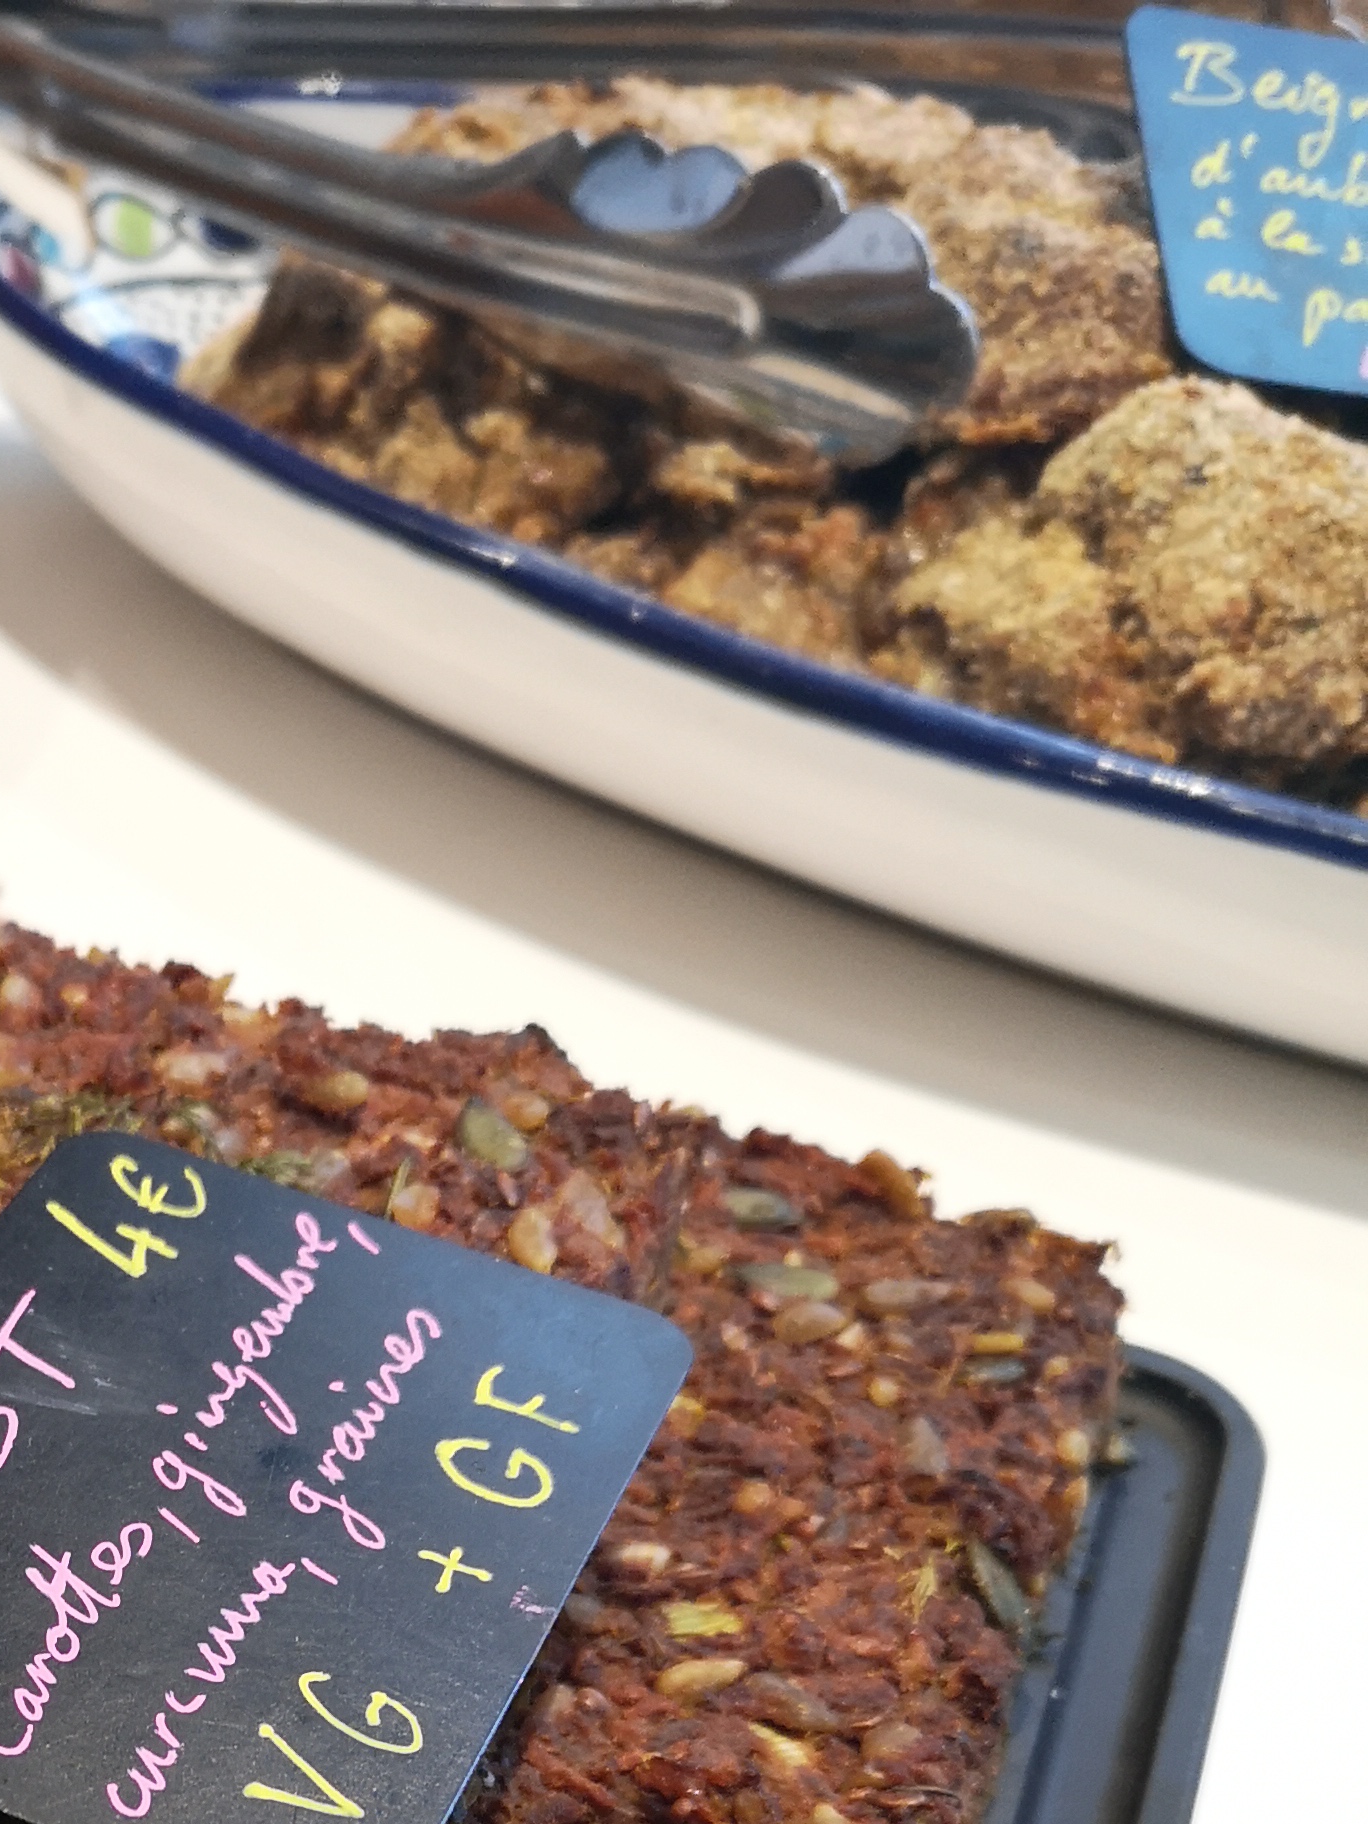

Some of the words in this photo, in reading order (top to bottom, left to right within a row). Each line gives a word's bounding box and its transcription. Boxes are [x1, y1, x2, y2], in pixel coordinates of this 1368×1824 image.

[45, 1155, 206, 1278] 4€
[106, 1558, 338, 1818] curcuma,
[289, 1307, 444, 1550] graines
[242, 1671, 424, 1819] VG
[434, 1364, 582, 1508] GF
